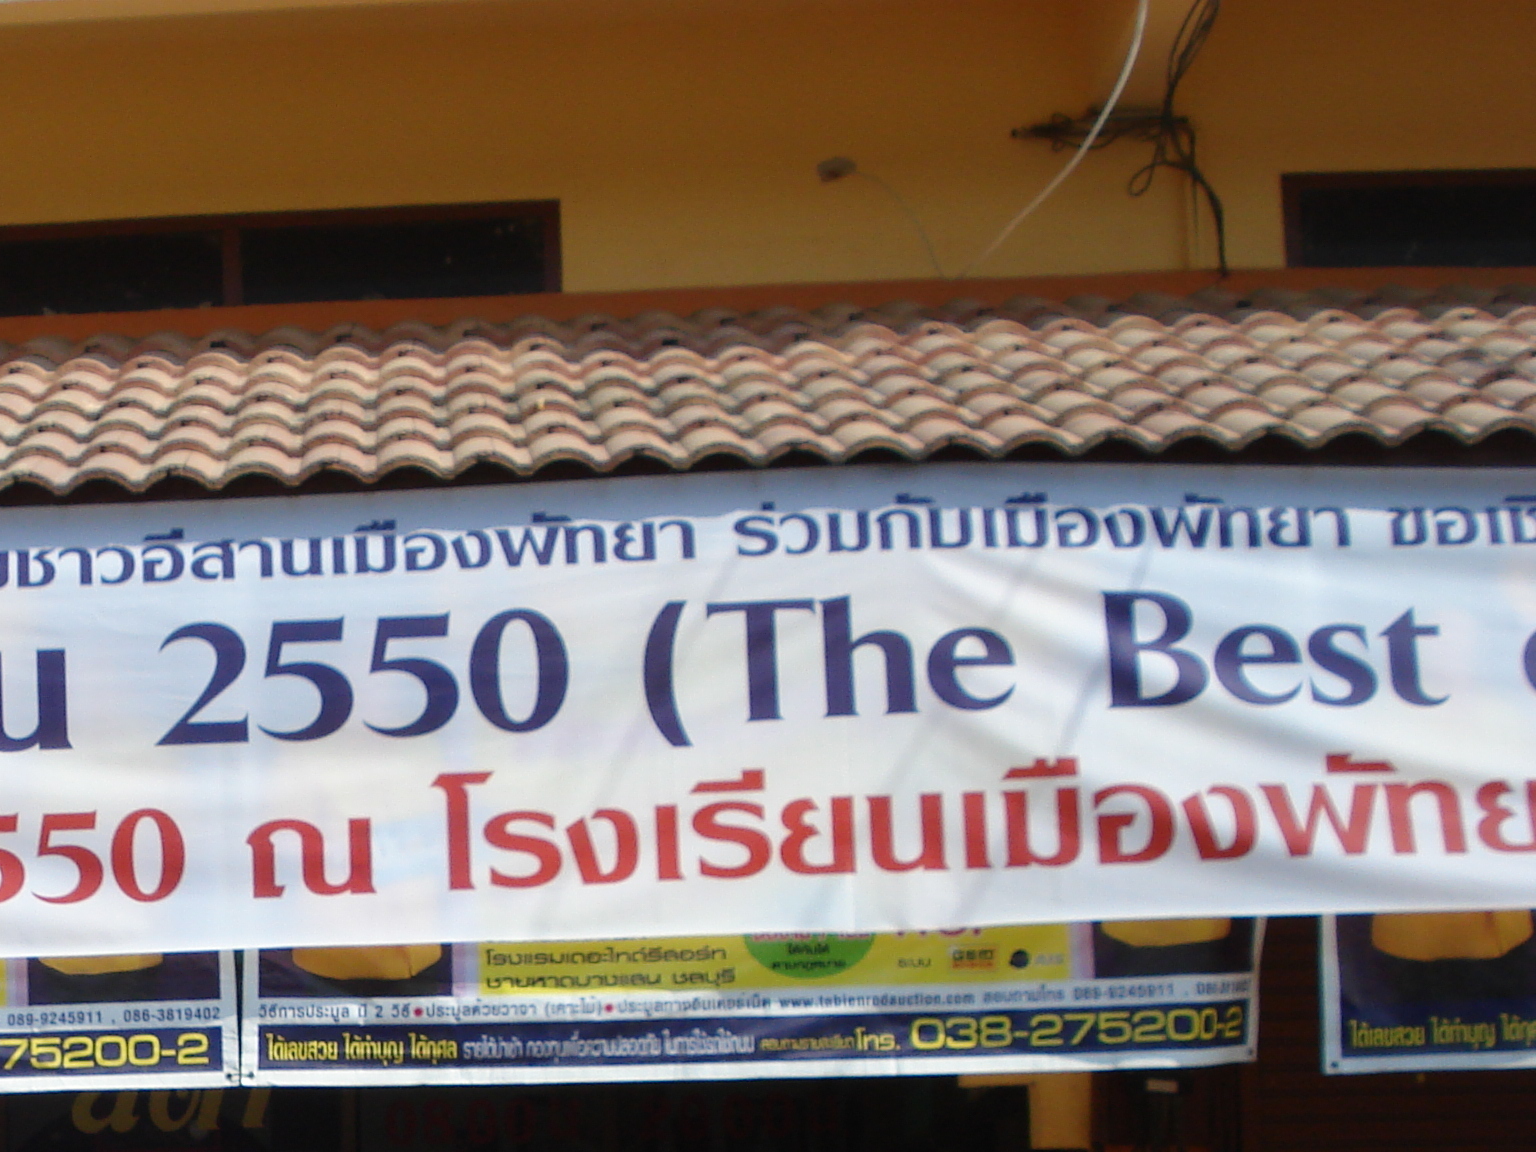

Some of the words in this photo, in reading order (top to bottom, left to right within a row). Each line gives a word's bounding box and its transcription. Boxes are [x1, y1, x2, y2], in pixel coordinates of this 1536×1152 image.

[735, 493, 1351, 557] ร่วมกับเมืองพัทยา
[155, 608, 569, 746] 2550
[643, 593, 1015, 746] (The
[1102, 589, 1450, 708] Best
[246, 816, 376, 898] ณ
